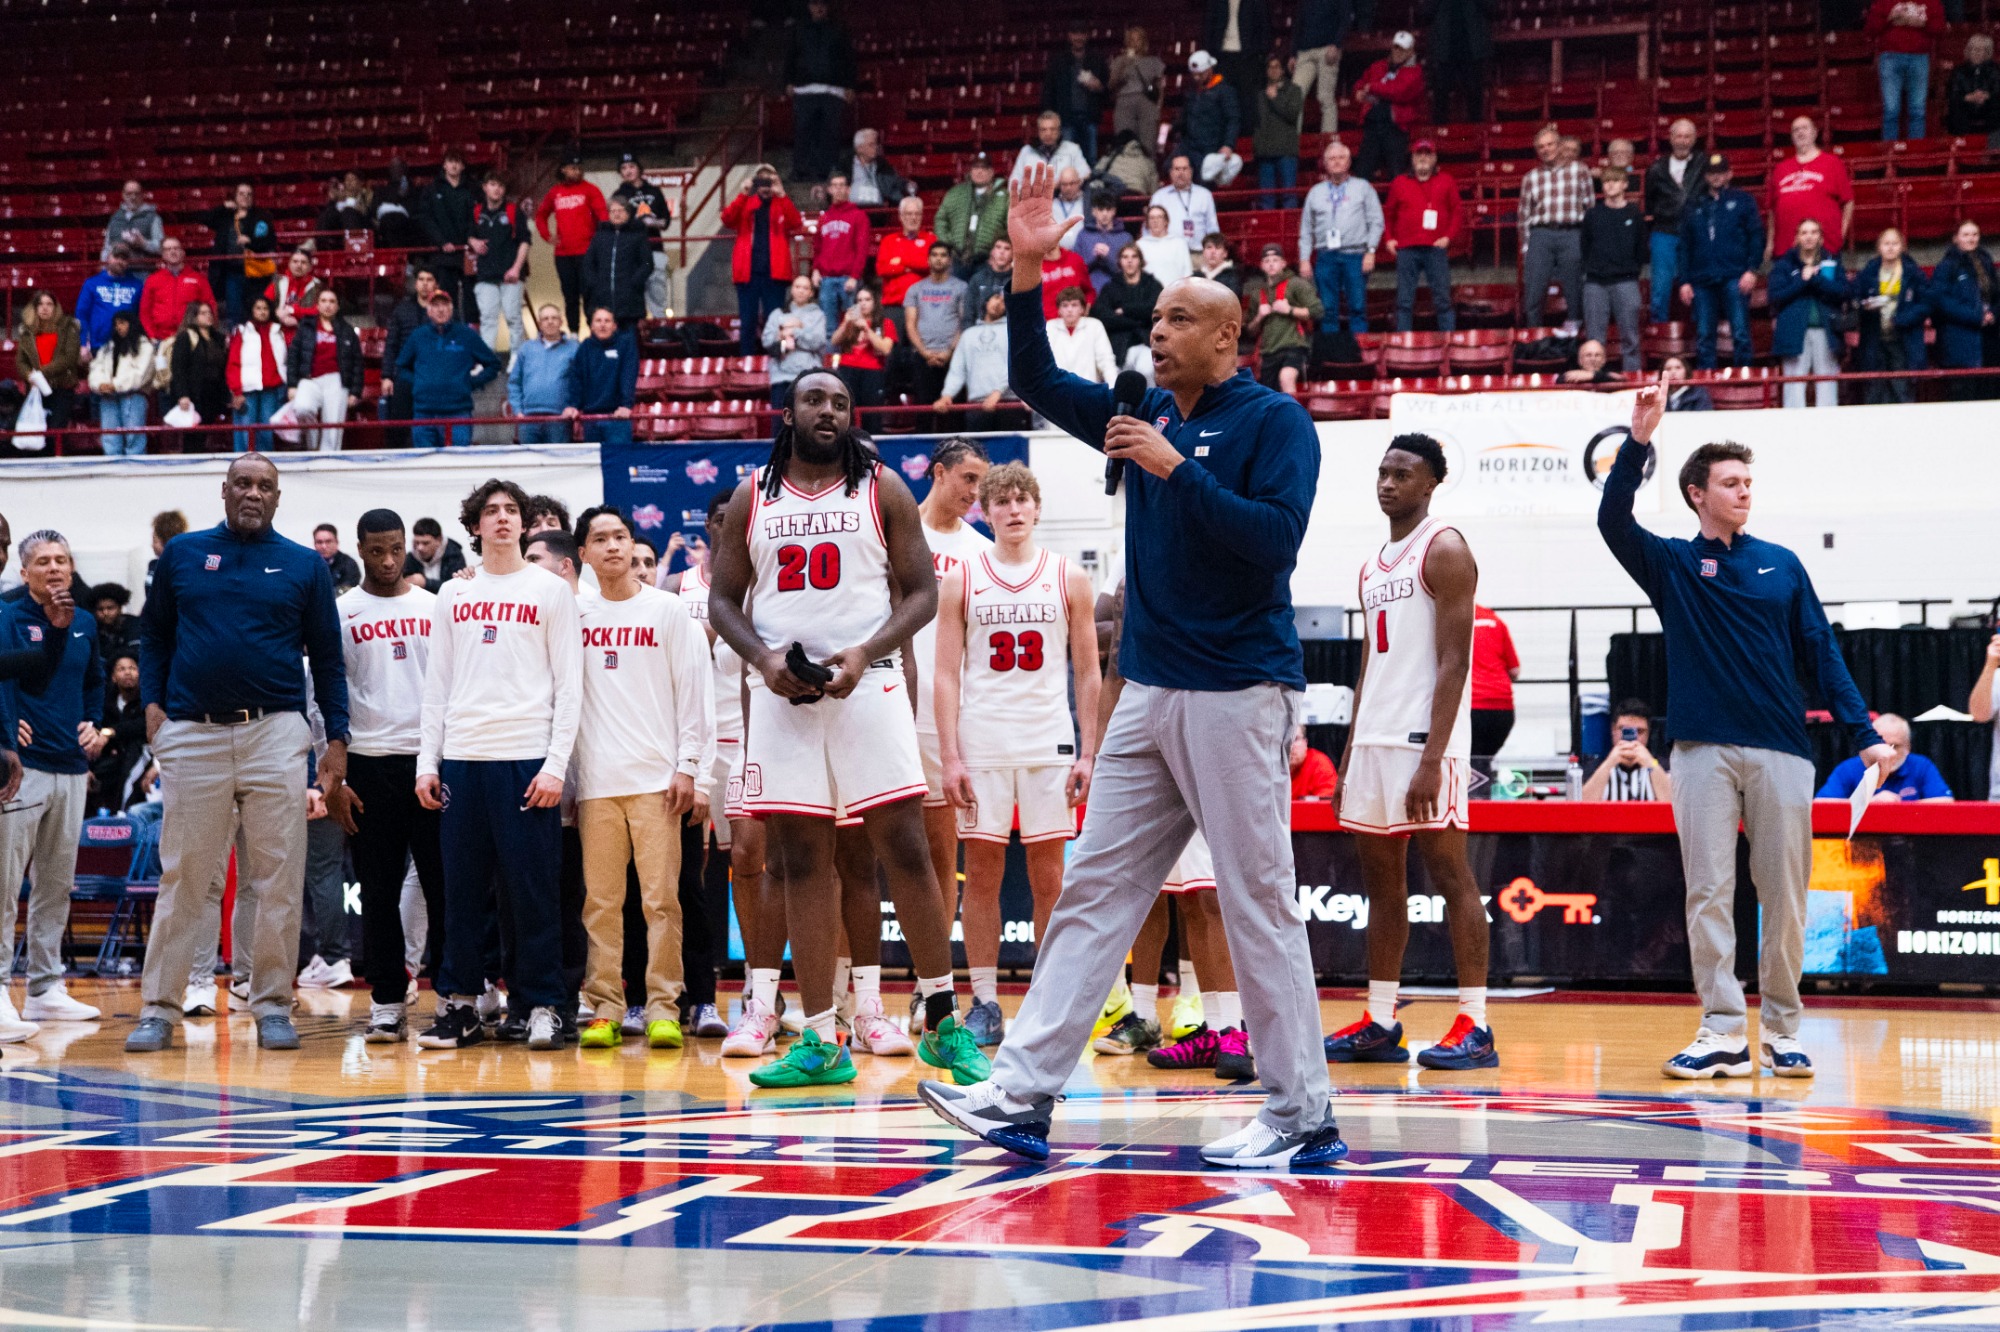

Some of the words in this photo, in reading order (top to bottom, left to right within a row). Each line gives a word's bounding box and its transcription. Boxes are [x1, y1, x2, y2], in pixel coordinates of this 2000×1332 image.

[1406, 398, 1438, 414] WE
[1446, 397, 1482, 413] ARE
[1491, 397, 1528, 412] ALL
[1589, 396, 1631, 412] TEA
[1479, 457, 1569, 472] HORIZON
[765, 511, 860, 540] TITANS
[777, 541, 841, 592] 20
[453, 601, 495, 624] LOCK
[497, 602, 516, 622] IT
[517, 604, 540, 626] IN.
[976, 603, 1057, 625] TITANS
[351, 618, 399, 645] LOCK
[400, 618, 416, 637] IT
[583, 626, 614, 648] OCK
[616, 626, 632, 647] IT
[633, 626, 659, 648] IN.
[1376, 609, 1390, 654] 1
[989, 630, 1044, 672] 33
[1298, 885, 1493, 929] Keya
